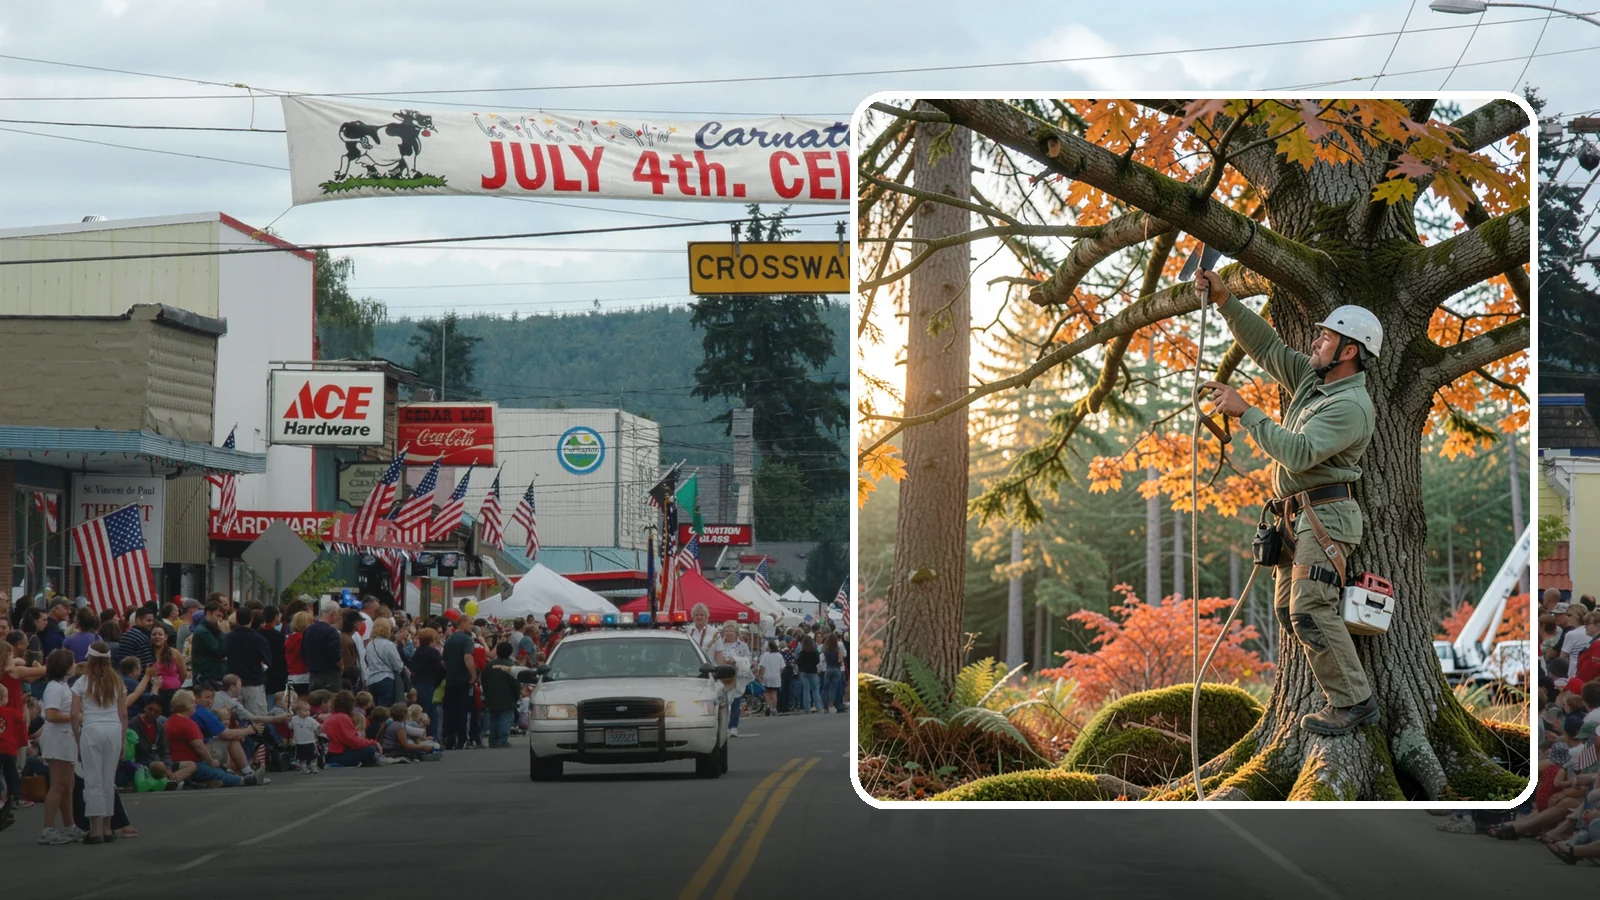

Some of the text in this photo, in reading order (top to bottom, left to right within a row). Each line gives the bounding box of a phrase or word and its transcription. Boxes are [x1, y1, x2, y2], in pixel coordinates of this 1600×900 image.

[481, 141, 605, 192] JULY
[632, 150, 746, 197] 4th.
[697, 254, 850, 280] CROSSWA
[283, 380, 373, 420] ACE
[406, 409, 485, 421] CEDAR LOG
[283, 421, 371, 436] Hardware
[353, 467, 385, 481] Simpl
[95, 485, 124, 494] Vincent
[126, 486, 136, 494] de
[137, 486, 155, 495] Paul
[688, 526, 741, 535] CRNATION
[699, 535, 730, 543] GLASS
